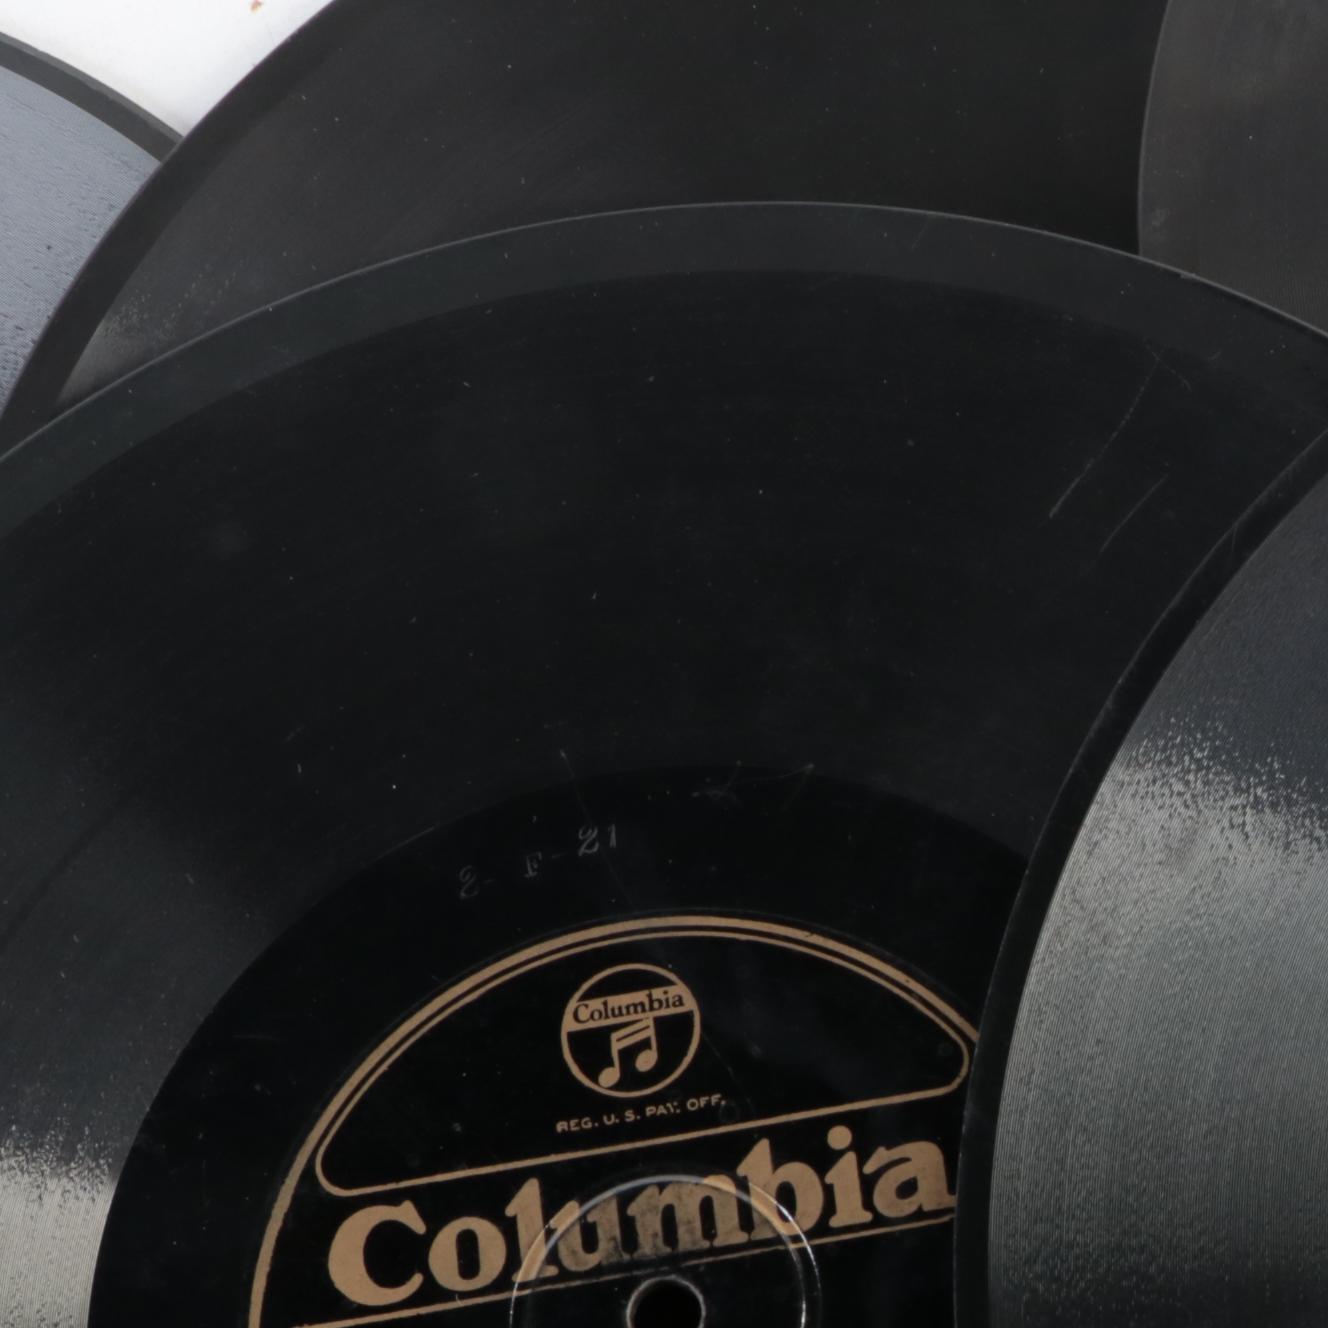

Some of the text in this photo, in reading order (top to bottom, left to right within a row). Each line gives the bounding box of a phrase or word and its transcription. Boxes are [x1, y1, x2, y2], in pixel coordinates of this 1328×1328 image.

[572, 989, 686, 1024] Columbia
[555, 1116, 599, 1134] REG.
[686, 1093, 727, 1112] OFF.
[327, 1125, 957, 1307] Columbia
